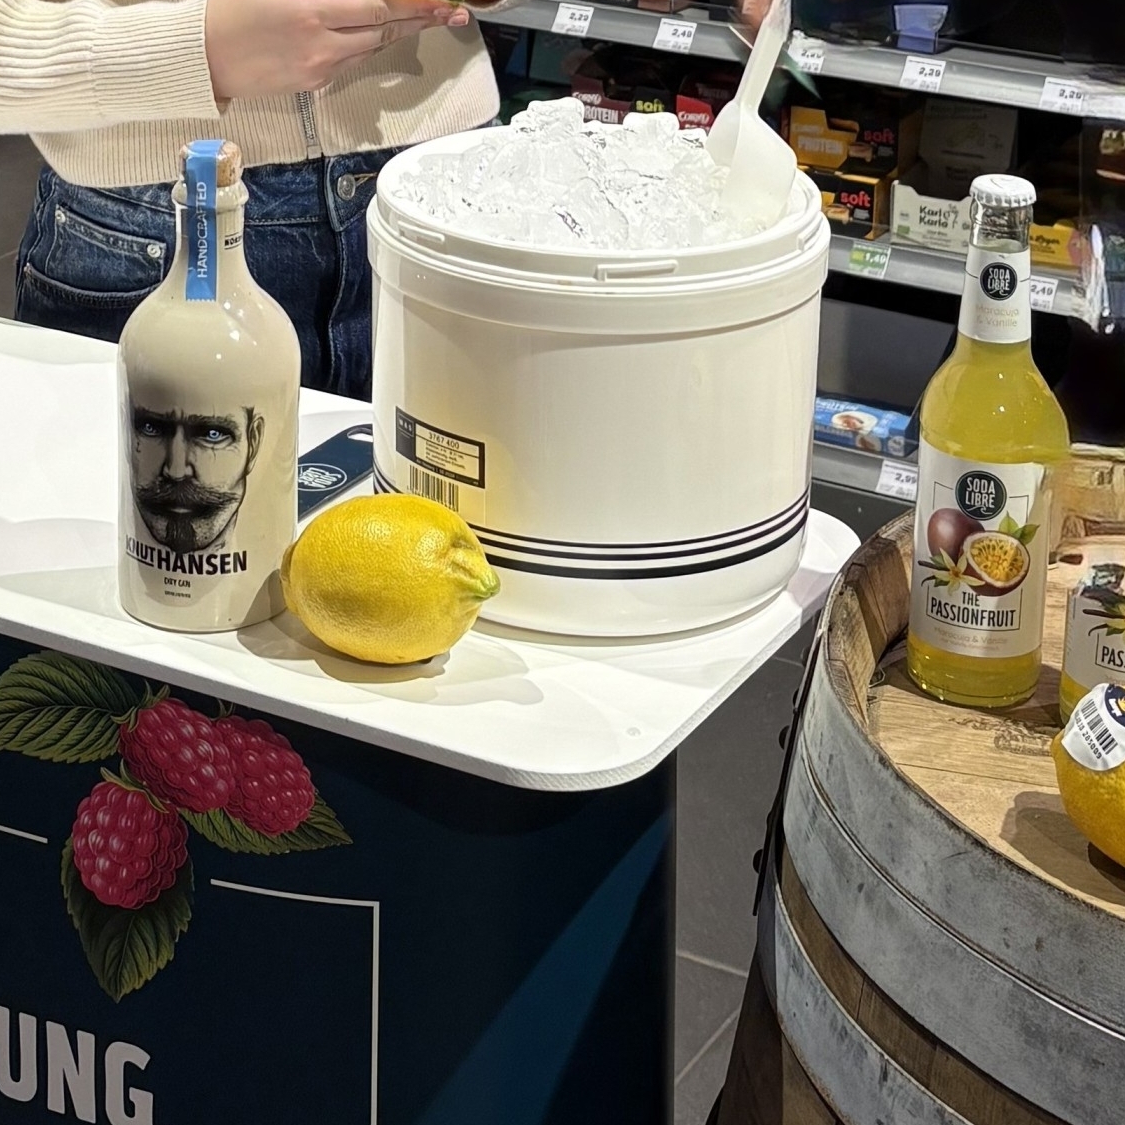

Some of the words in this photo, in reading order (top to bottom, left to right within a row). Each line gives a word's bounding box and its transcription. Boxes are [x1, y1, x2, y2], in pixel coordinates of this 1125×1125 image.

[584, 104, 619, 123] ROTEIN
[863, 127, 895, 145] soft
[840, 190, 871, 208] soft
[919, 204, 942, 218] Karl
[196, 181, 208, 279] HANDCRAFTED
[988, 267, 1011, 280] SODA
[987, 277, 1011, 291] LIBRE
[446, 440, 460, 450] 400
[966, 476, 996, 496] SODA
[965, 491, 996, 509] LIBRE
[125, 534, 248, 576] KNUTHANSEN
[961, 591, 980, 607] THE
[930, 596, 1017, 628] PASSIONFRUIT
